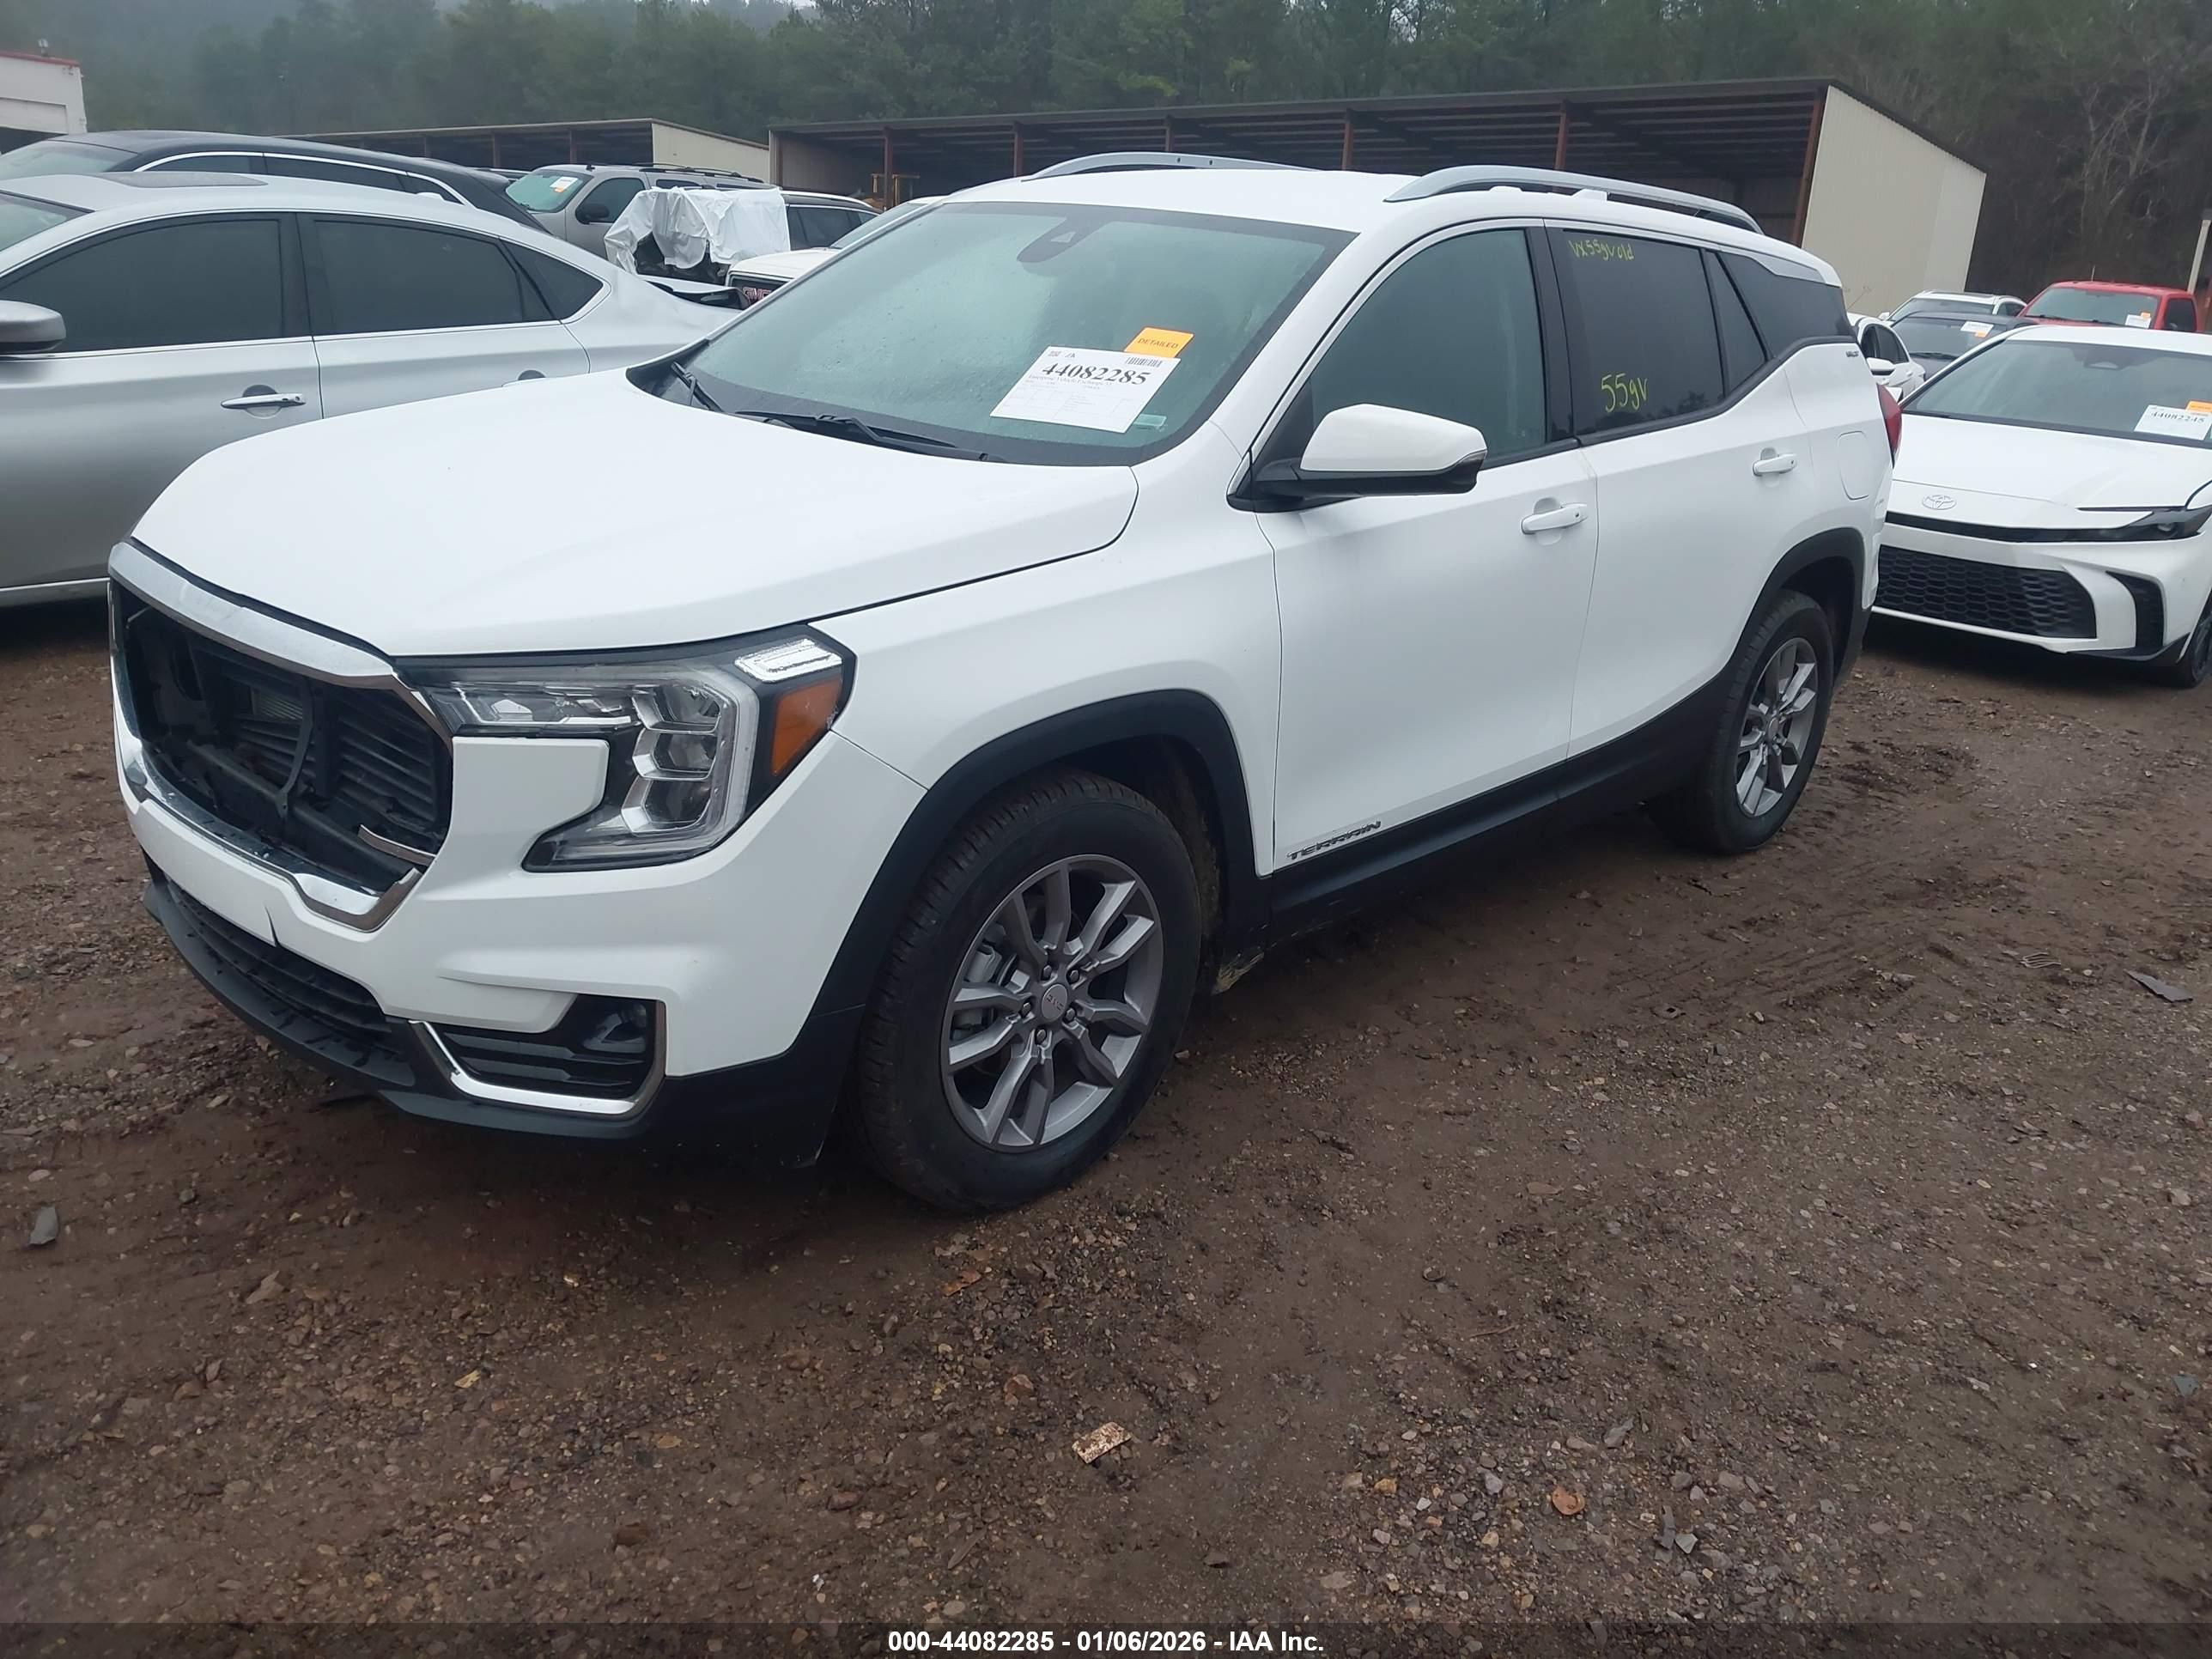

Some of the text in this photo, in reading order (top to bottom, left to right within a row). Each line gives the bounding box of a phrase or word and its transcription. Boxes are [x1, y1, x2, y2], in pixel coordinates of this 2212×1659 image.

[1137, 337, 1179, 349] DETAILED
[1042, 362, 1152, 385] 44082285
[1286, 820, 1382, 860] TERRAIN
